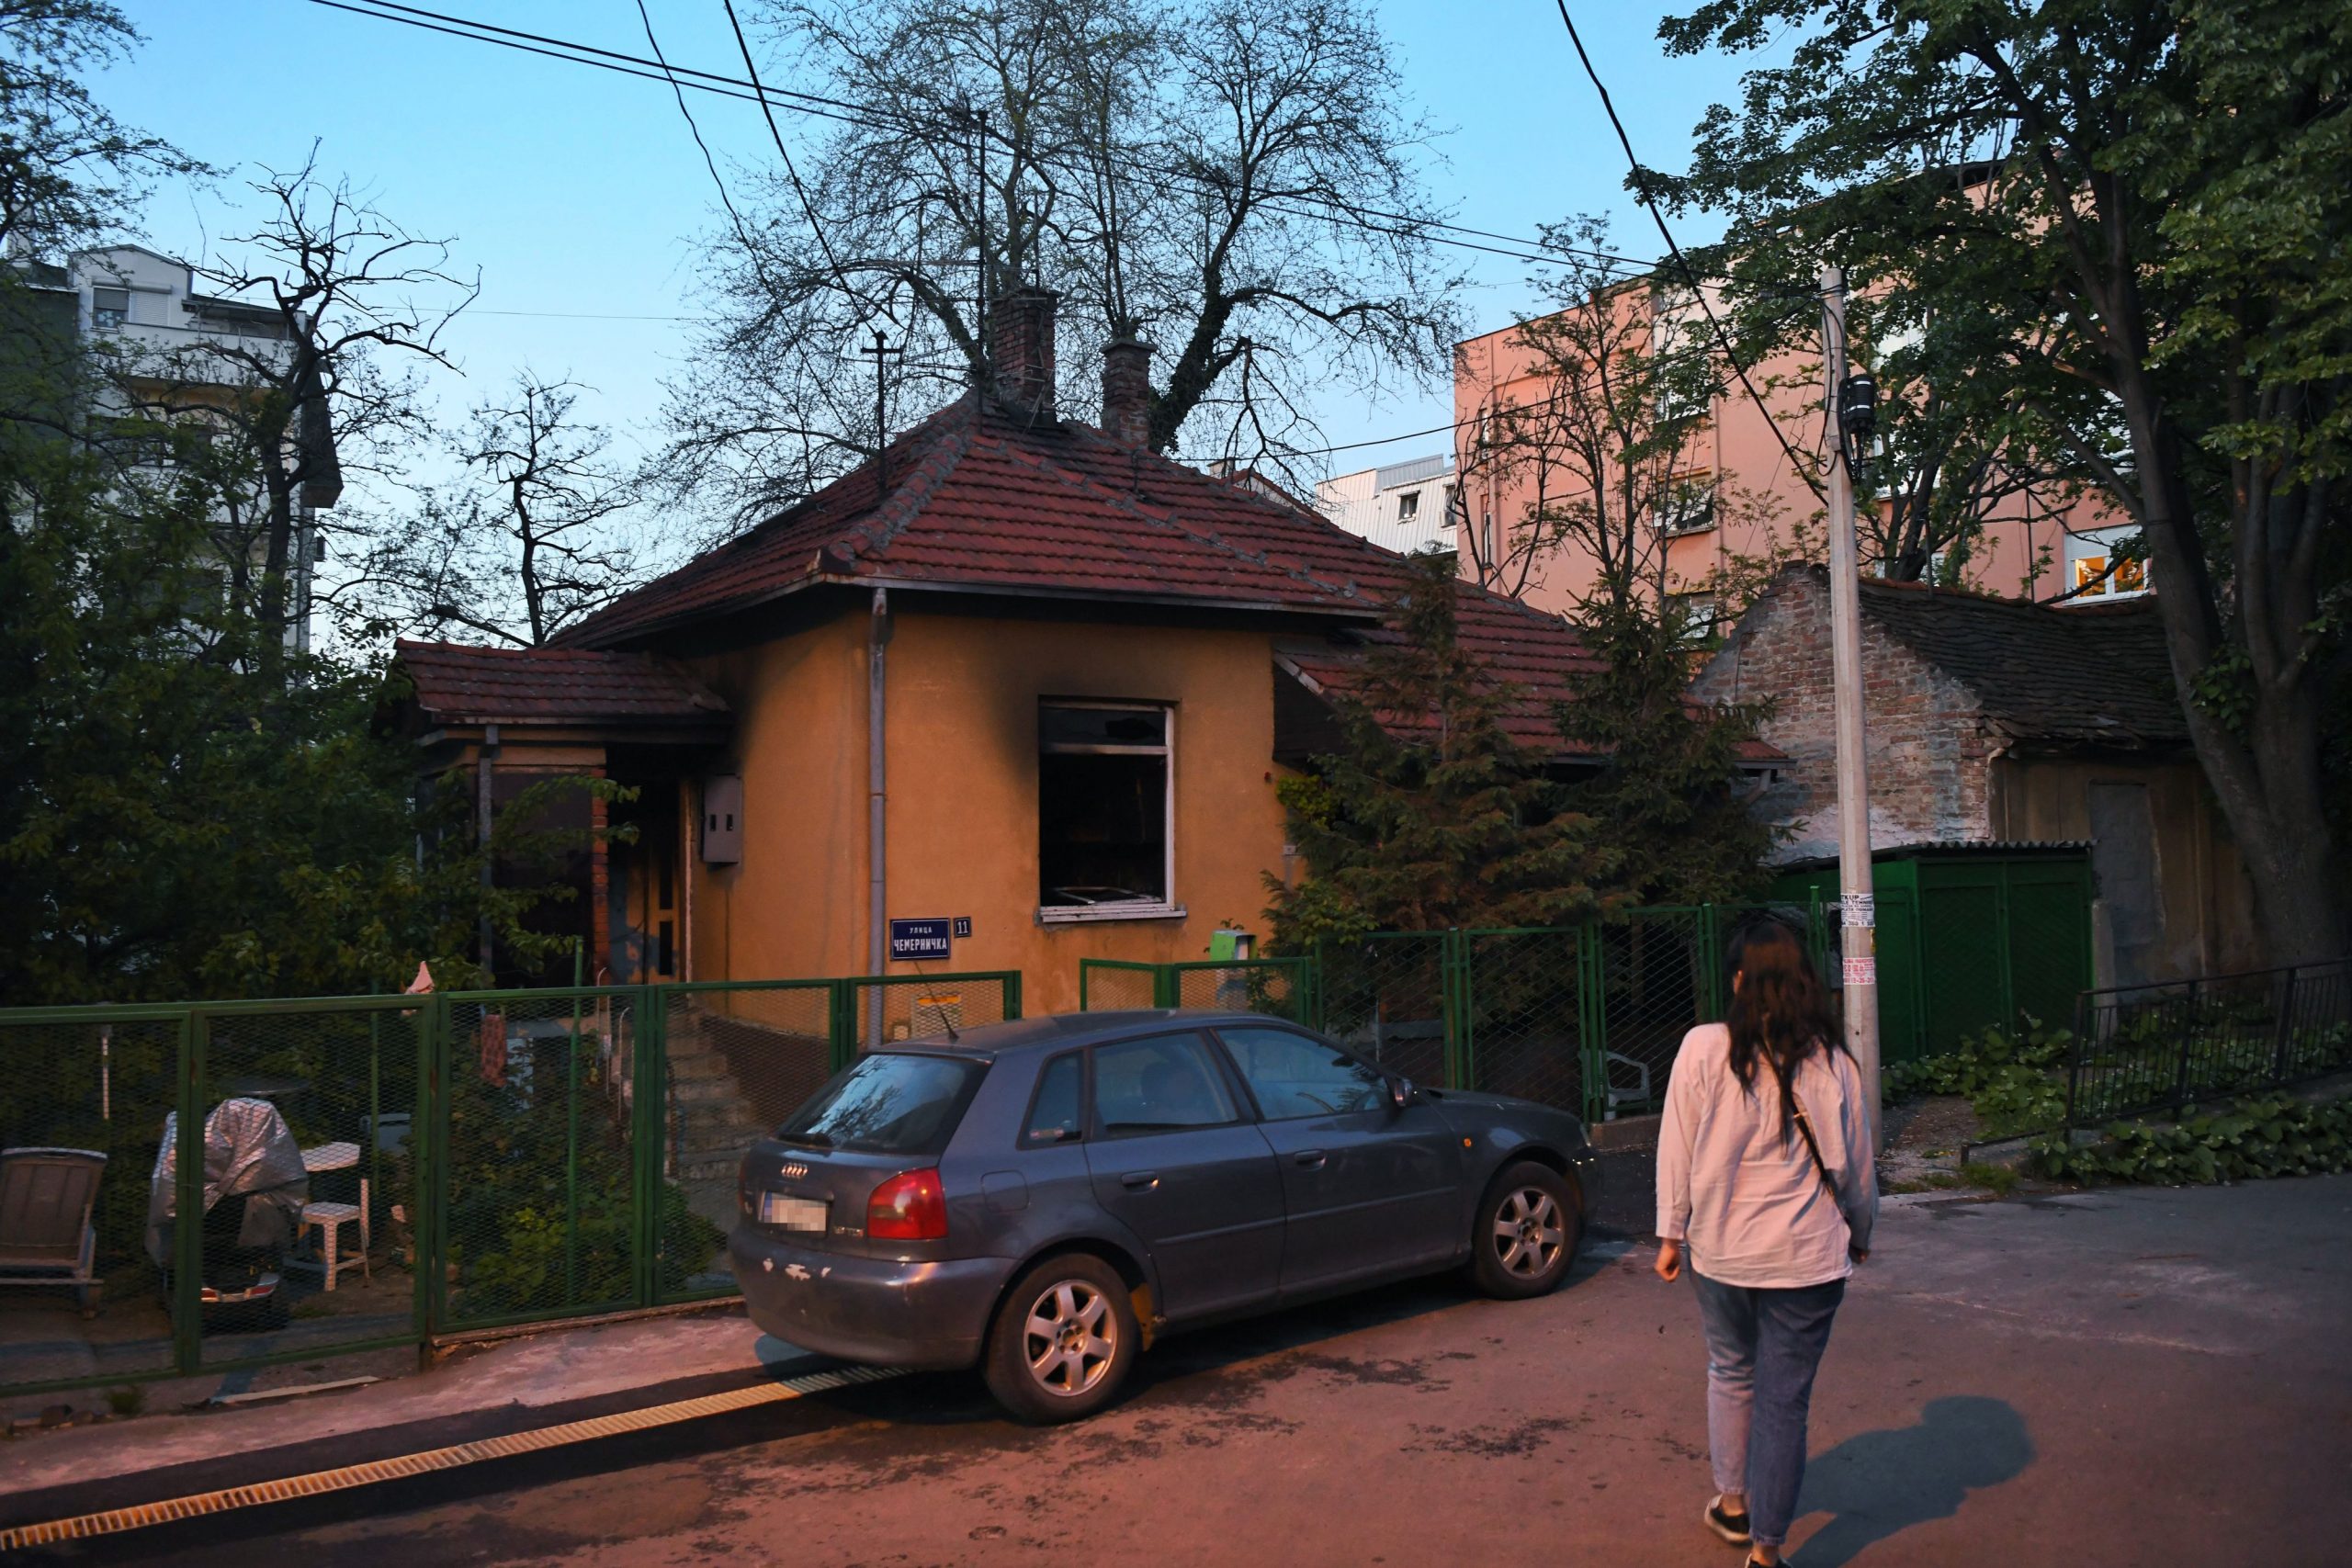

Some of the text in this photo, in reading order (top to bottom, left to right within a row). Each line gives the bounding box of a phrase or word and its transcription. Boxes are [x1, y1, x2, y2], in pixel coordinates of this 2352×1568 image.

[910, 926, 933, 934] УЛИЦА
[957, 920, 968, 934] 11
[894, 938, 947, 952] ЧЕМЕРНИЧКА
